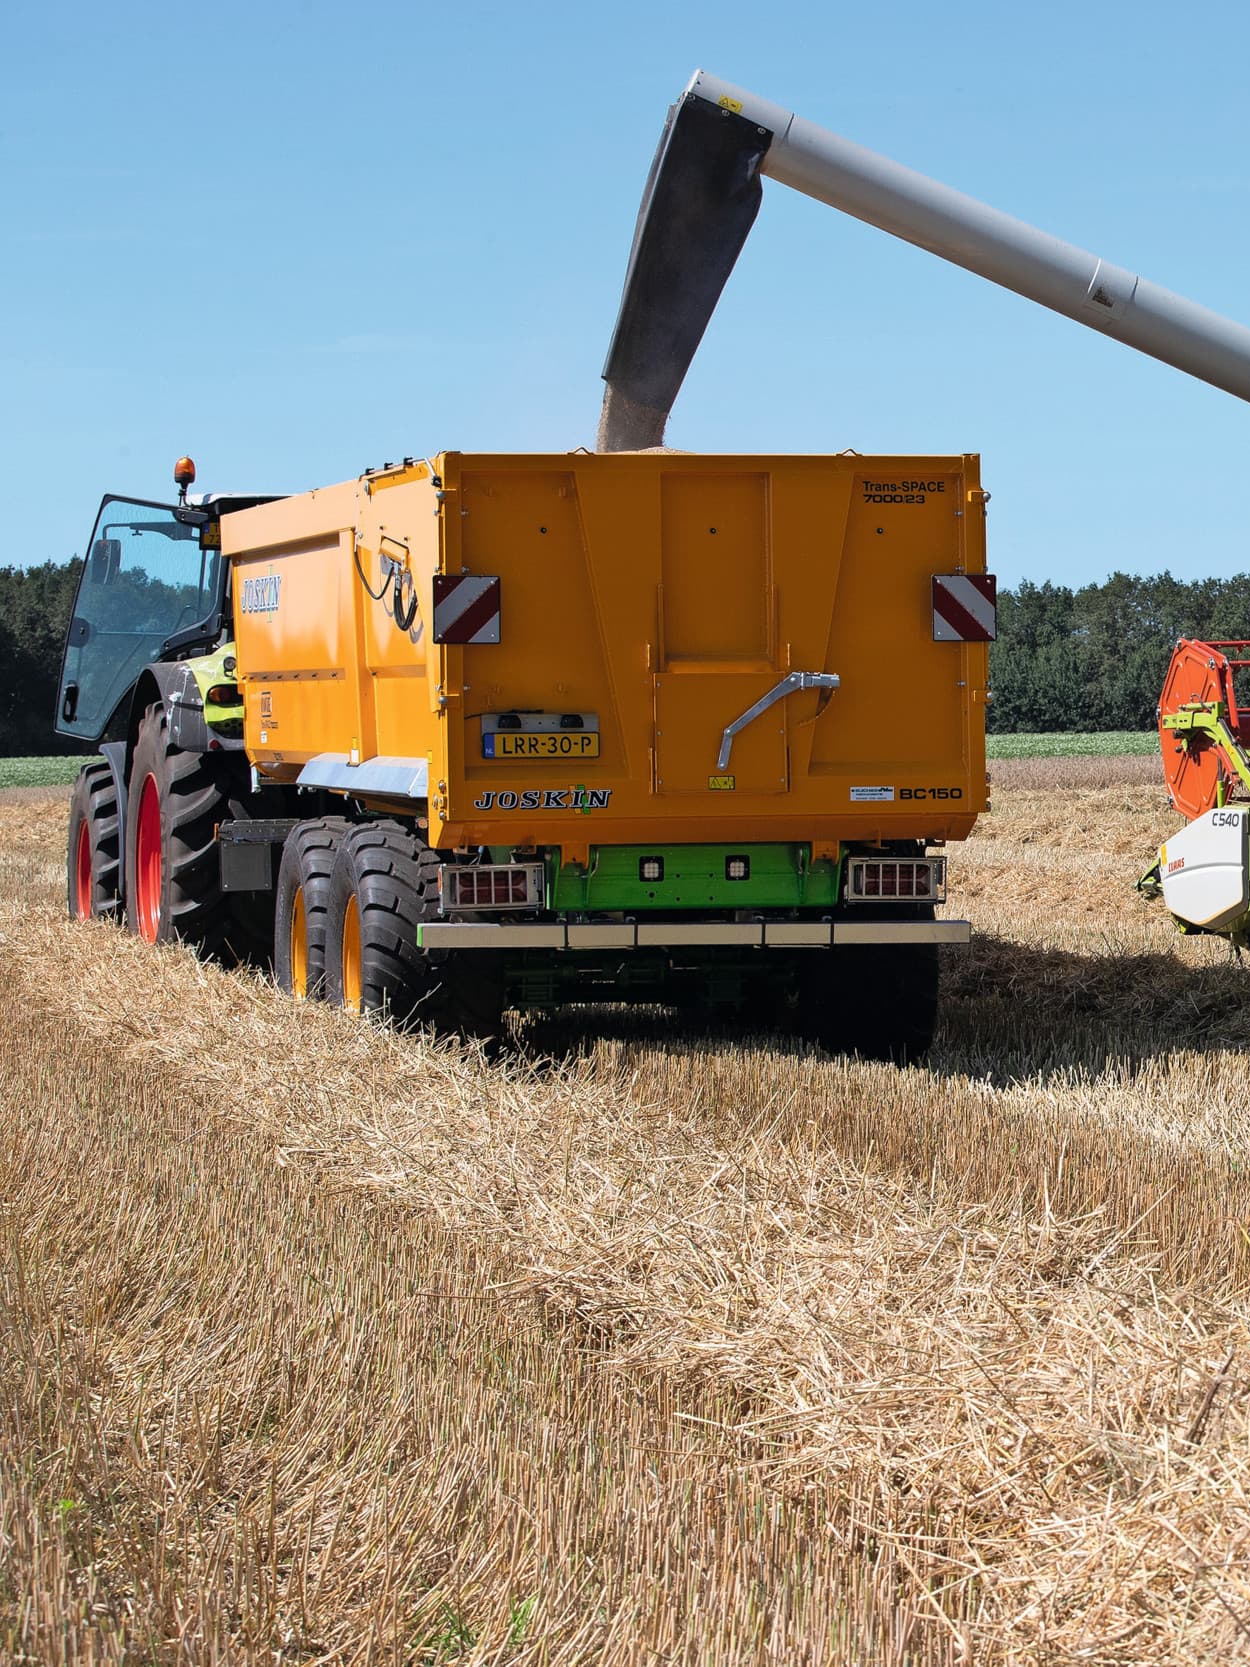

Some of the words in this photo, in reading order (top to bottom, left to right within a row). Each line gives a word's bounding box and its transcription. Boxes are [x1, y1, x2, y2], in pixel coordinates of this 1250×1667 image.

[863, 481, 945, 493] Trans-SPACE
[241, 575, 281, 614] JOSKIN
[502, 736, 592, 754] LRR-30-P
[474, 789, 612, 810] JOSKIN
